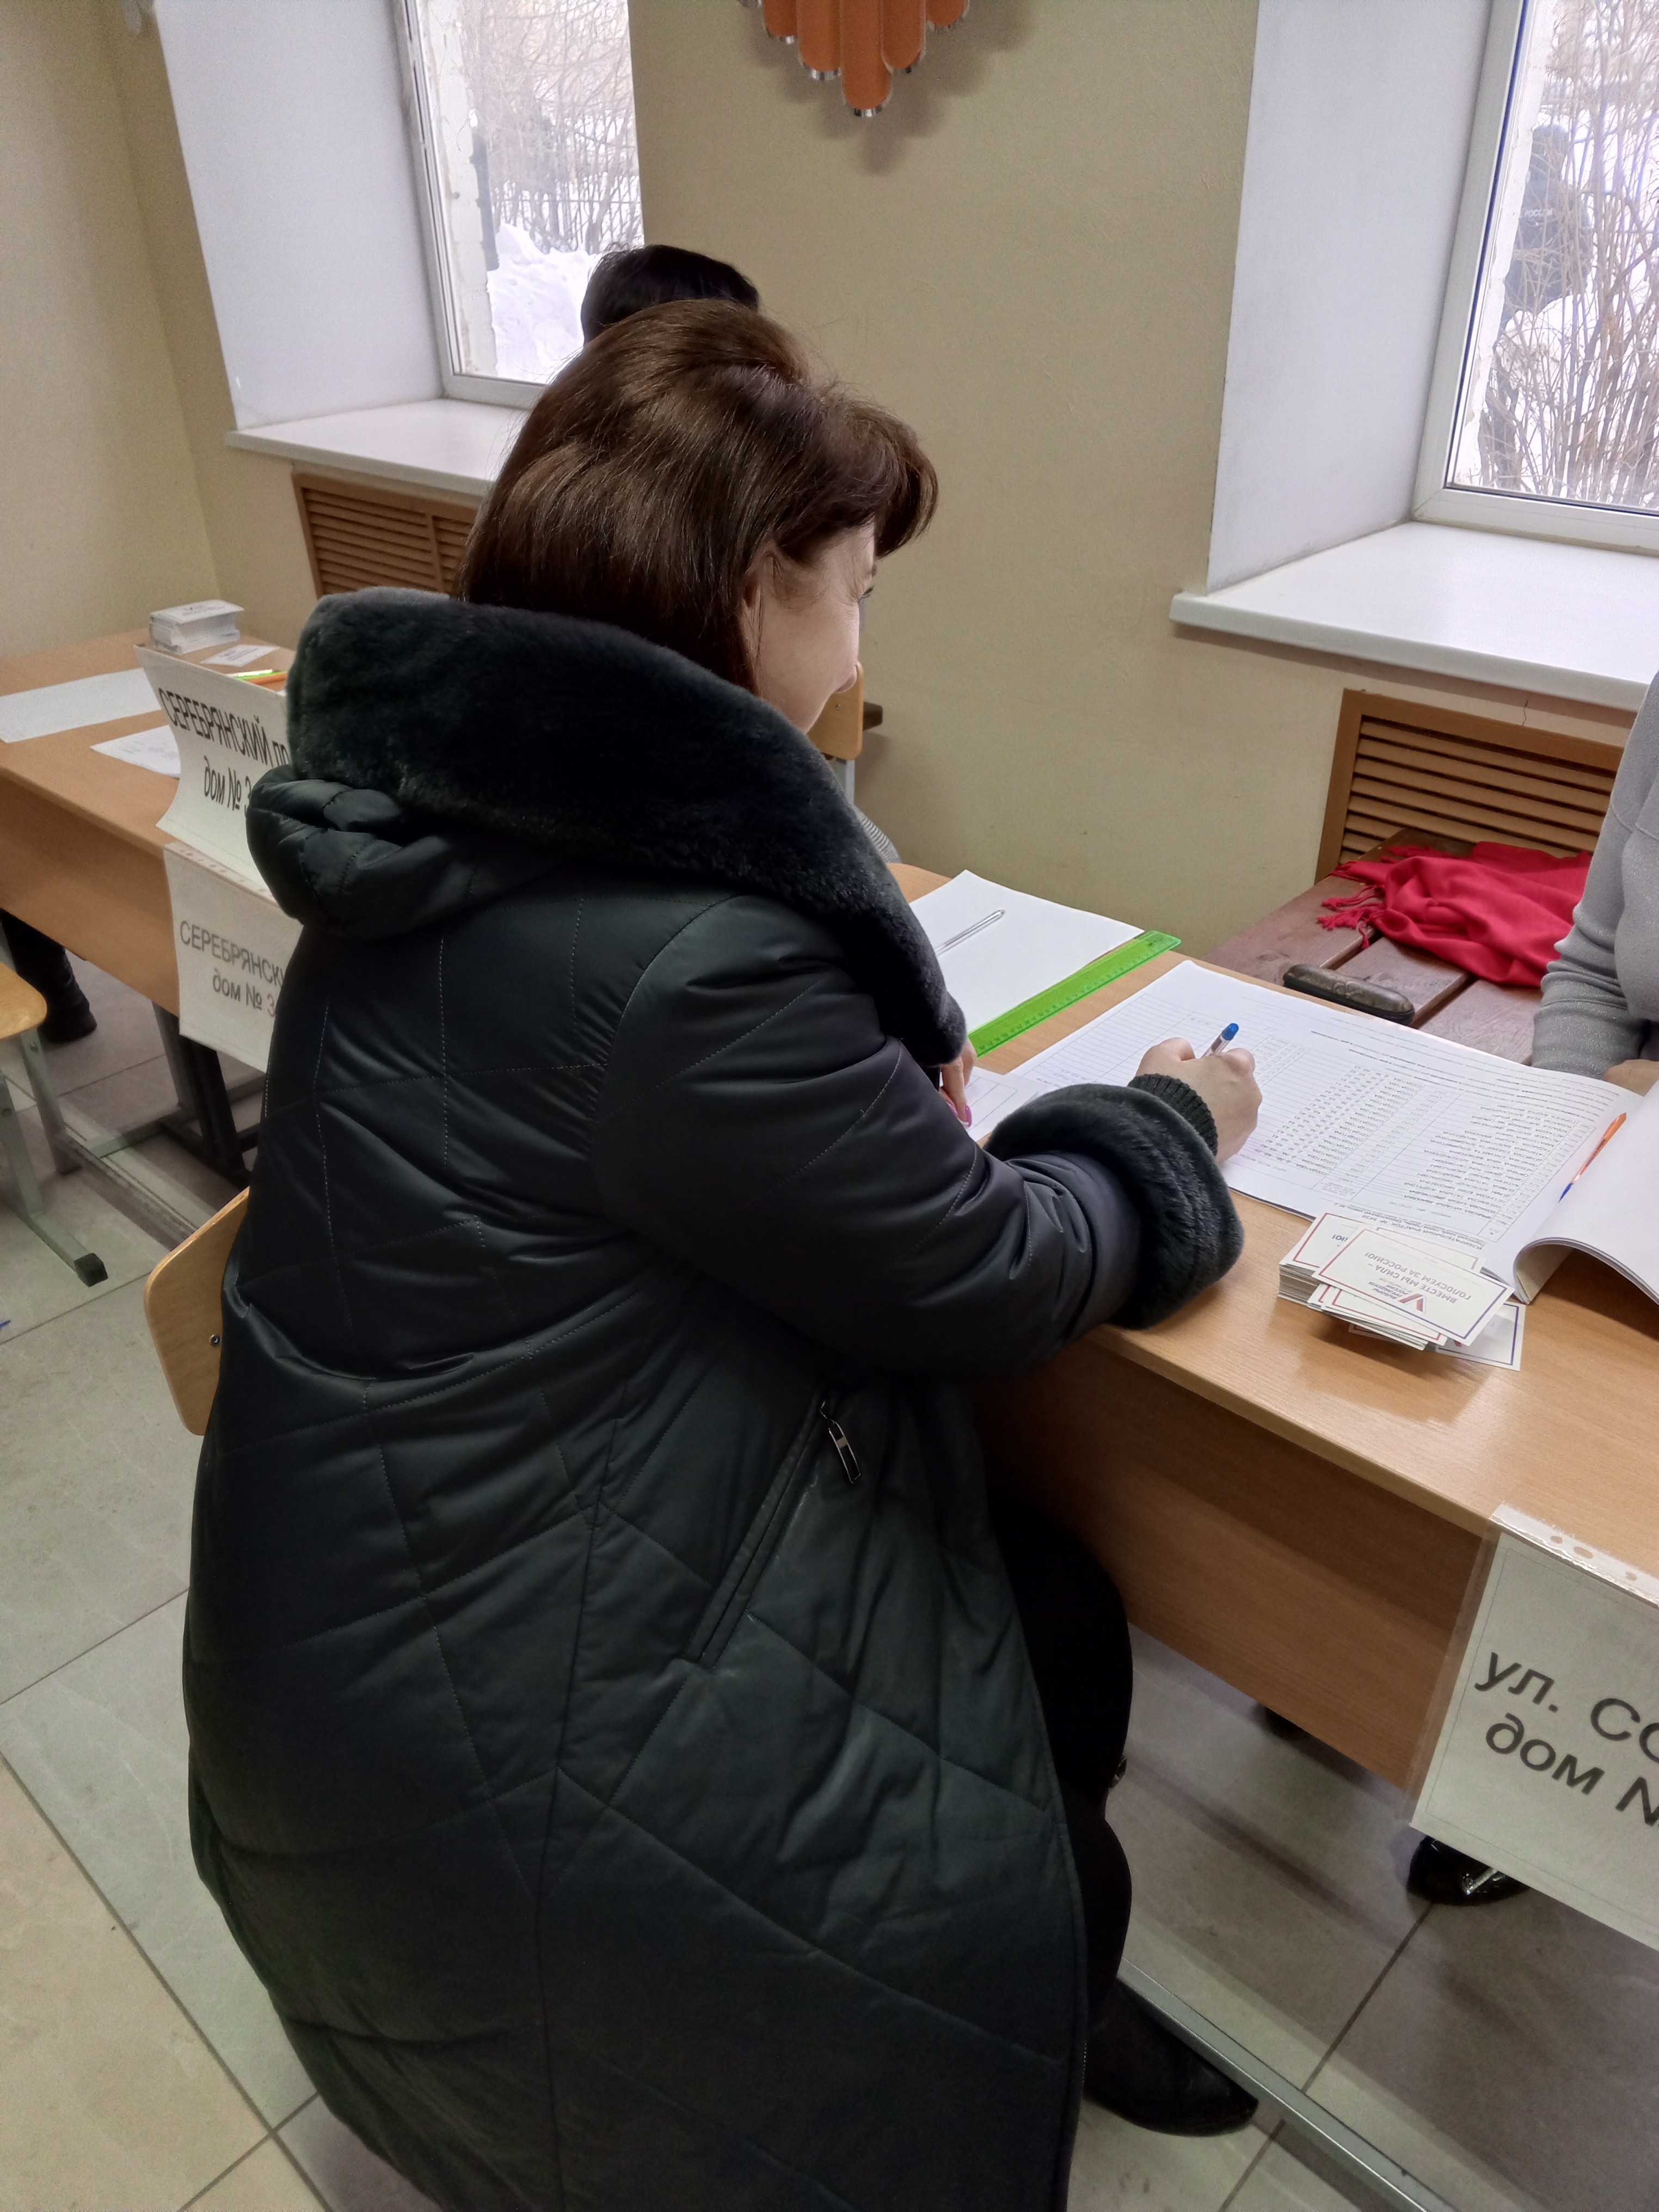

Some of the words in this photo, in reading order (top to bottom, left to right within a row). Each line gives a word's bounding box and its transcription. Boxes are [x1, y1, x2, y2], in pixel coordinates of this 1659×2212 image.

[158, 687, 273, 767] СЕРЕБРЯНСКИЙ
[204, 755, 225, 806] дом
[227, 767, 242, 811] №
[213, 968, 240, 1002] дом
[245, 983, 262, 1011] №
[1364, 1251, 1409, 1273] РОССИЮ!
[1375, 1265, 1400, 1280] СИЛА
[1409, 1269, 1421, 1278] ЗА
[1400, 1276, 1420, 1287] МЫ
[1420, 1283, 1458, 1304] ВМЕСТЕ
[1421, 1275, 1472, 1301] ГОЛОСУЕМ
[1474, 1652, 1559, 1713] ул.
[1486, 1712, 1605, 1795] дом
